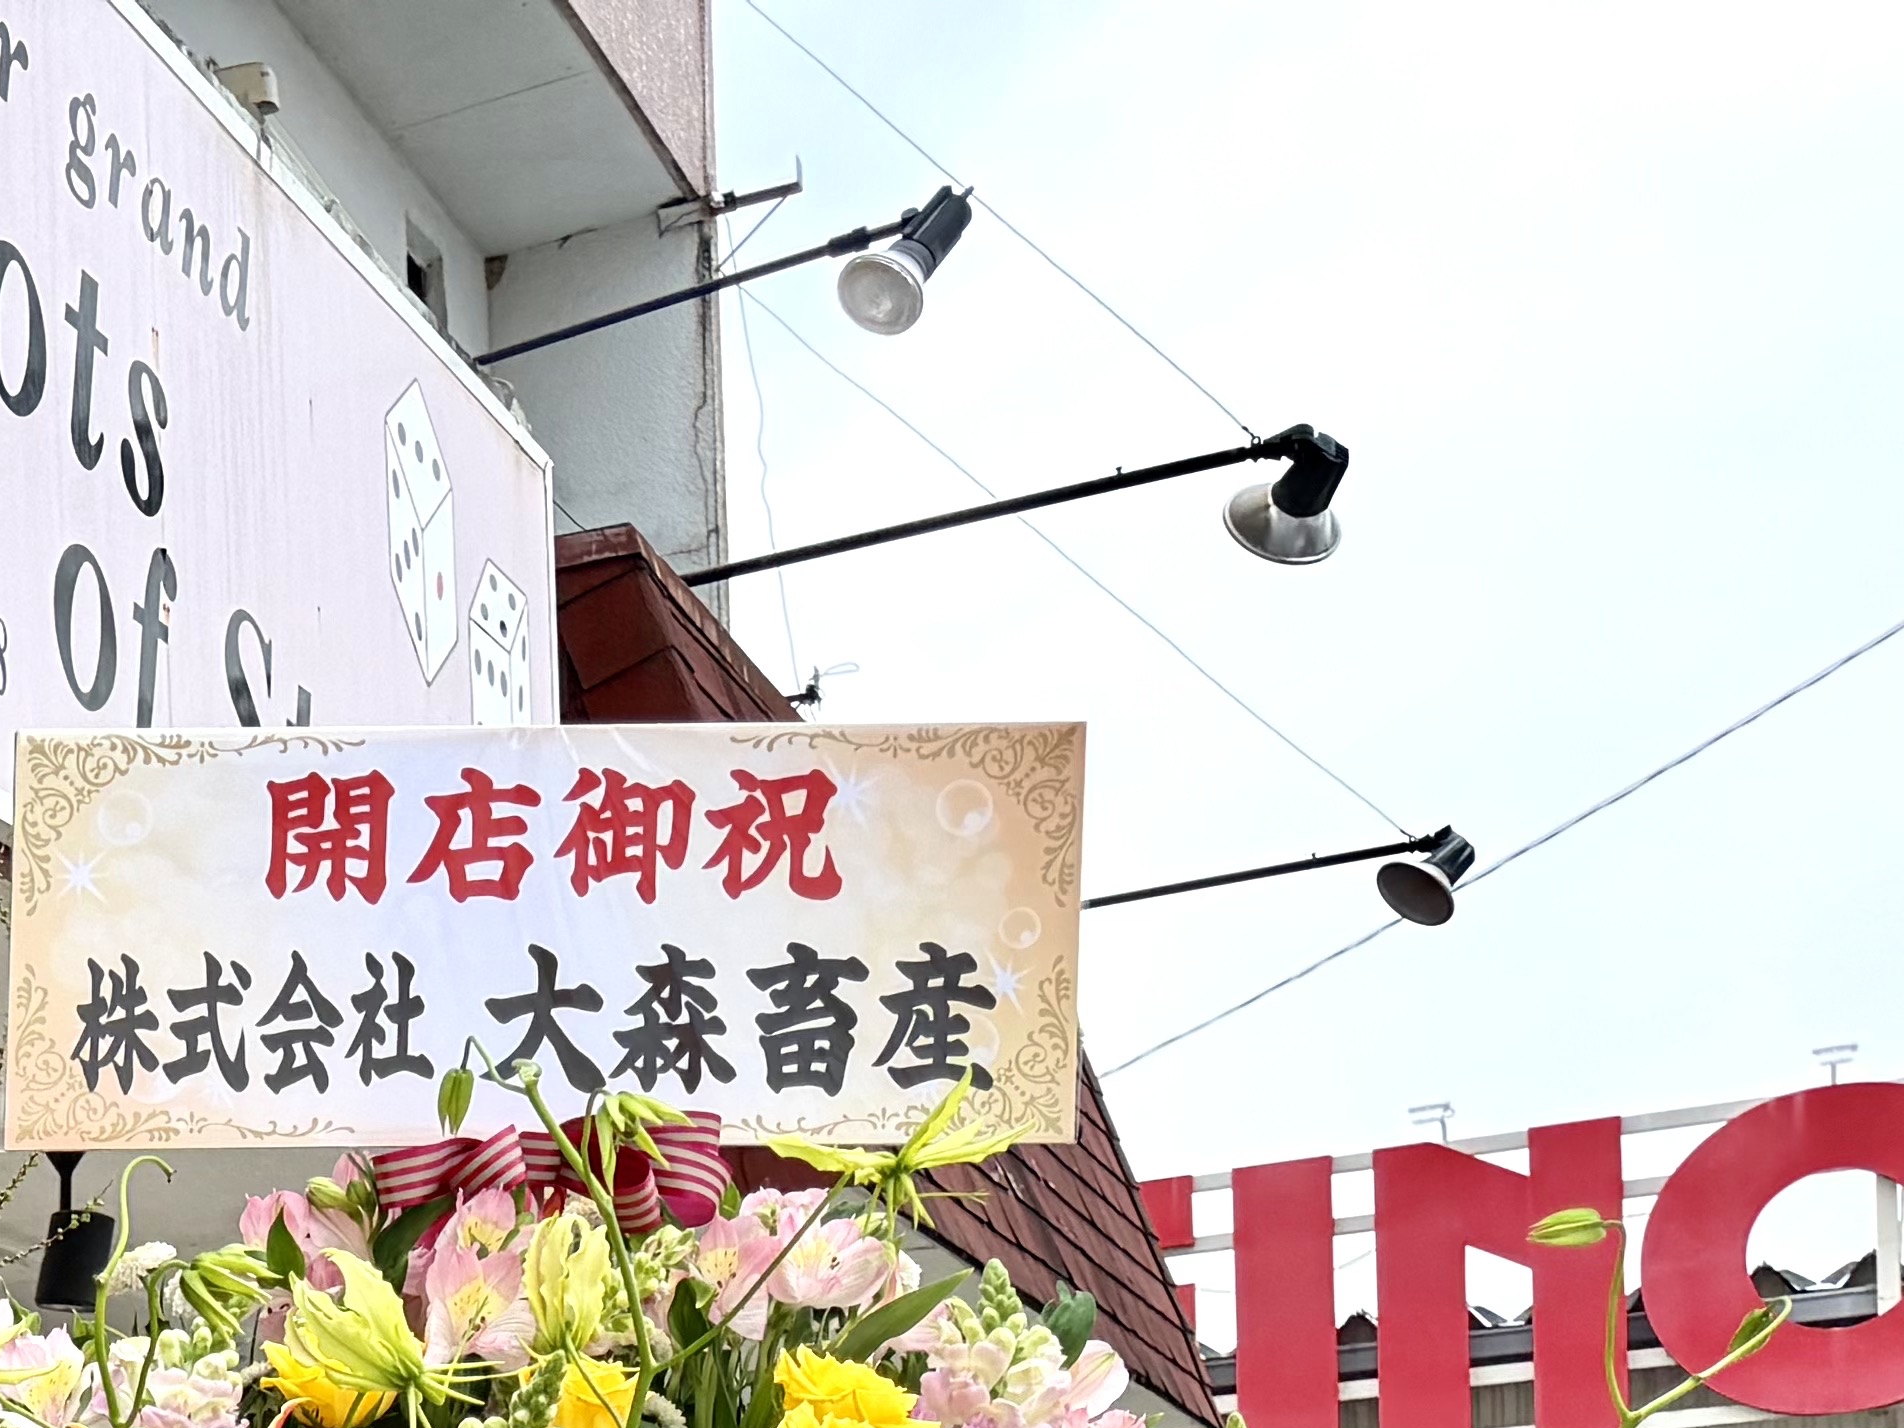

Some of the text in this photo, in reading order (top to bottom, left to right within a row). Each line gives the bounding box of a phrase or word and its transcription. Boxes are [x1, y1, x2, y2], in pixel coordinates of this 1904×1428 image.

[65, 92, 253, 332] grand
[263, 766, 845, 905] 開店御祝
[73, 942, 996, 1095] 株式会社 大森畜産
